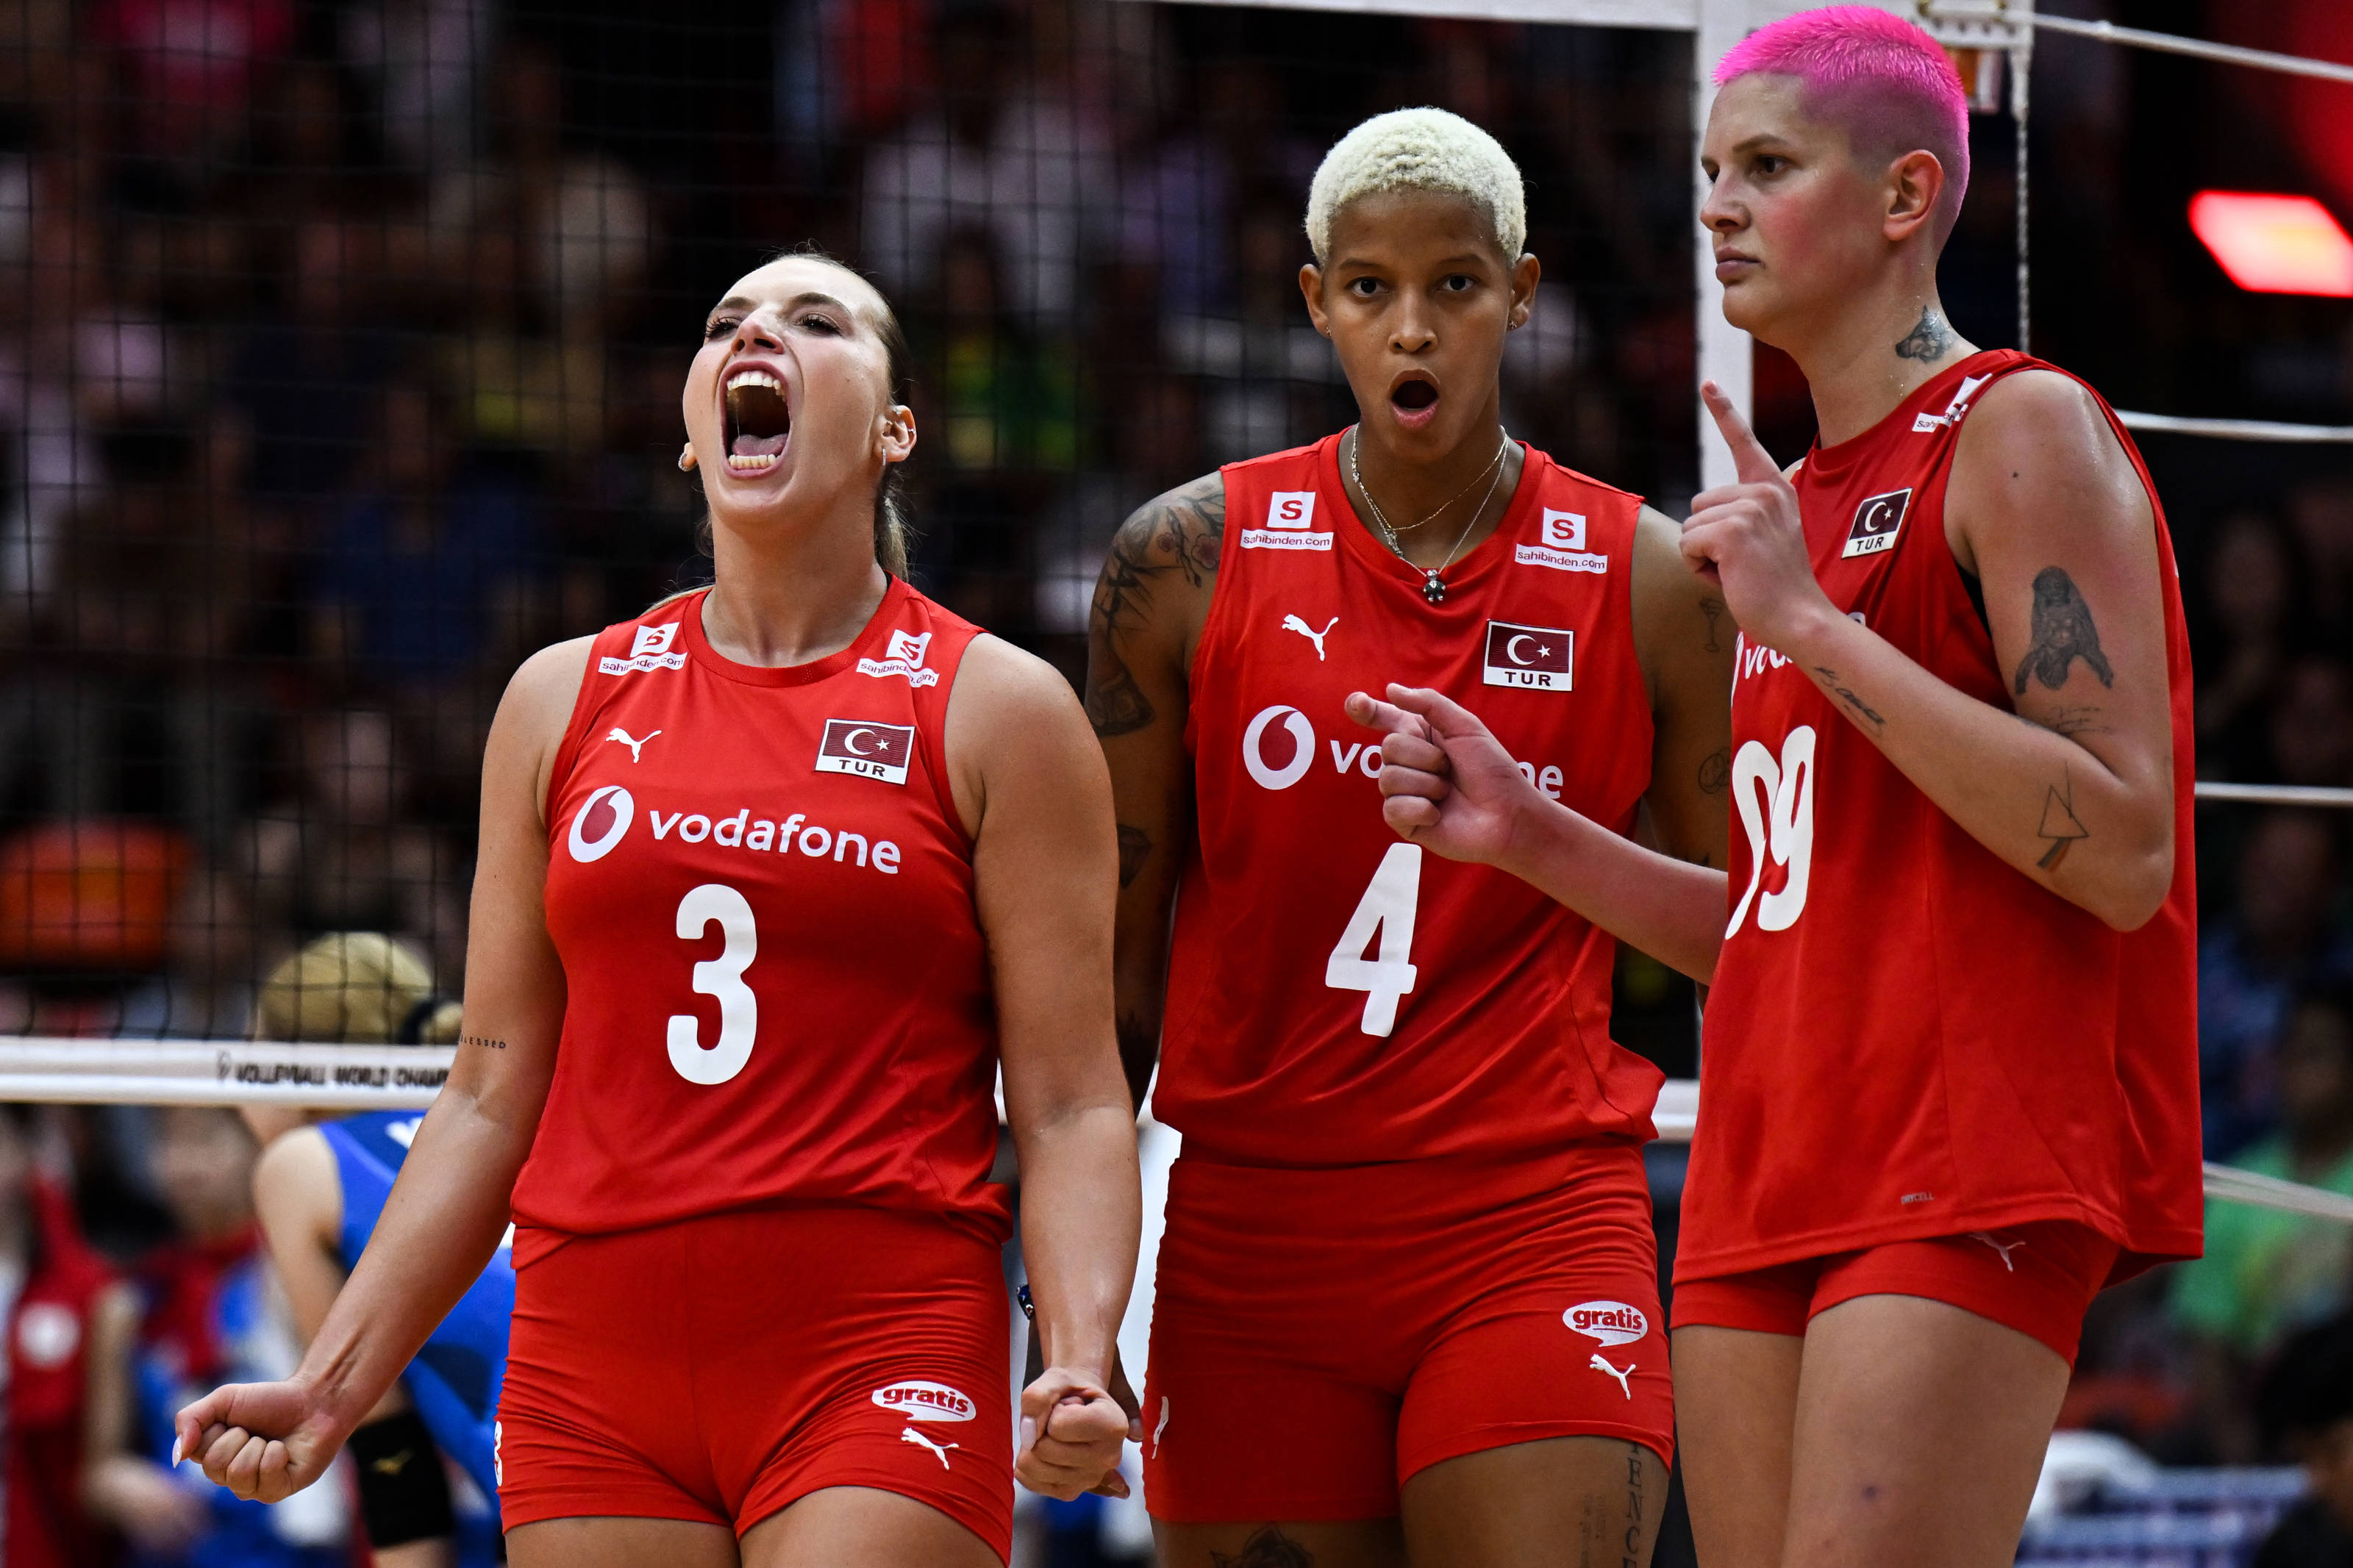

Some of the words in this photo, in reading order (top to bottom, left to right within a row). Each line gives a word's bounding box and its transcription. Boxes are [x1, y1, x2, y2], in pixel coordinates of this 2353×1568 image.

[1279, 500, 1303, 520] S
[1552, 519, 1575, 540] S
[1243, 534, 1330, 547] sahibinden.com
[1856, 537, 1885, 553] TUR
[1517, 551, 1605, 570] sahibinden.com
[899, 640, 921, 661] S
[1504, 670, 1552, 687] TUR
[838, 759, 886, 777] TUR
[649, 809, 901, 875] vodafone
[1325, 842, 1422, 1038] 4
[666, 884, 758, 1086] 3
[1573, 1308, 1643, 1330] gratis
[882, 1388, 969, 1413] gratis
